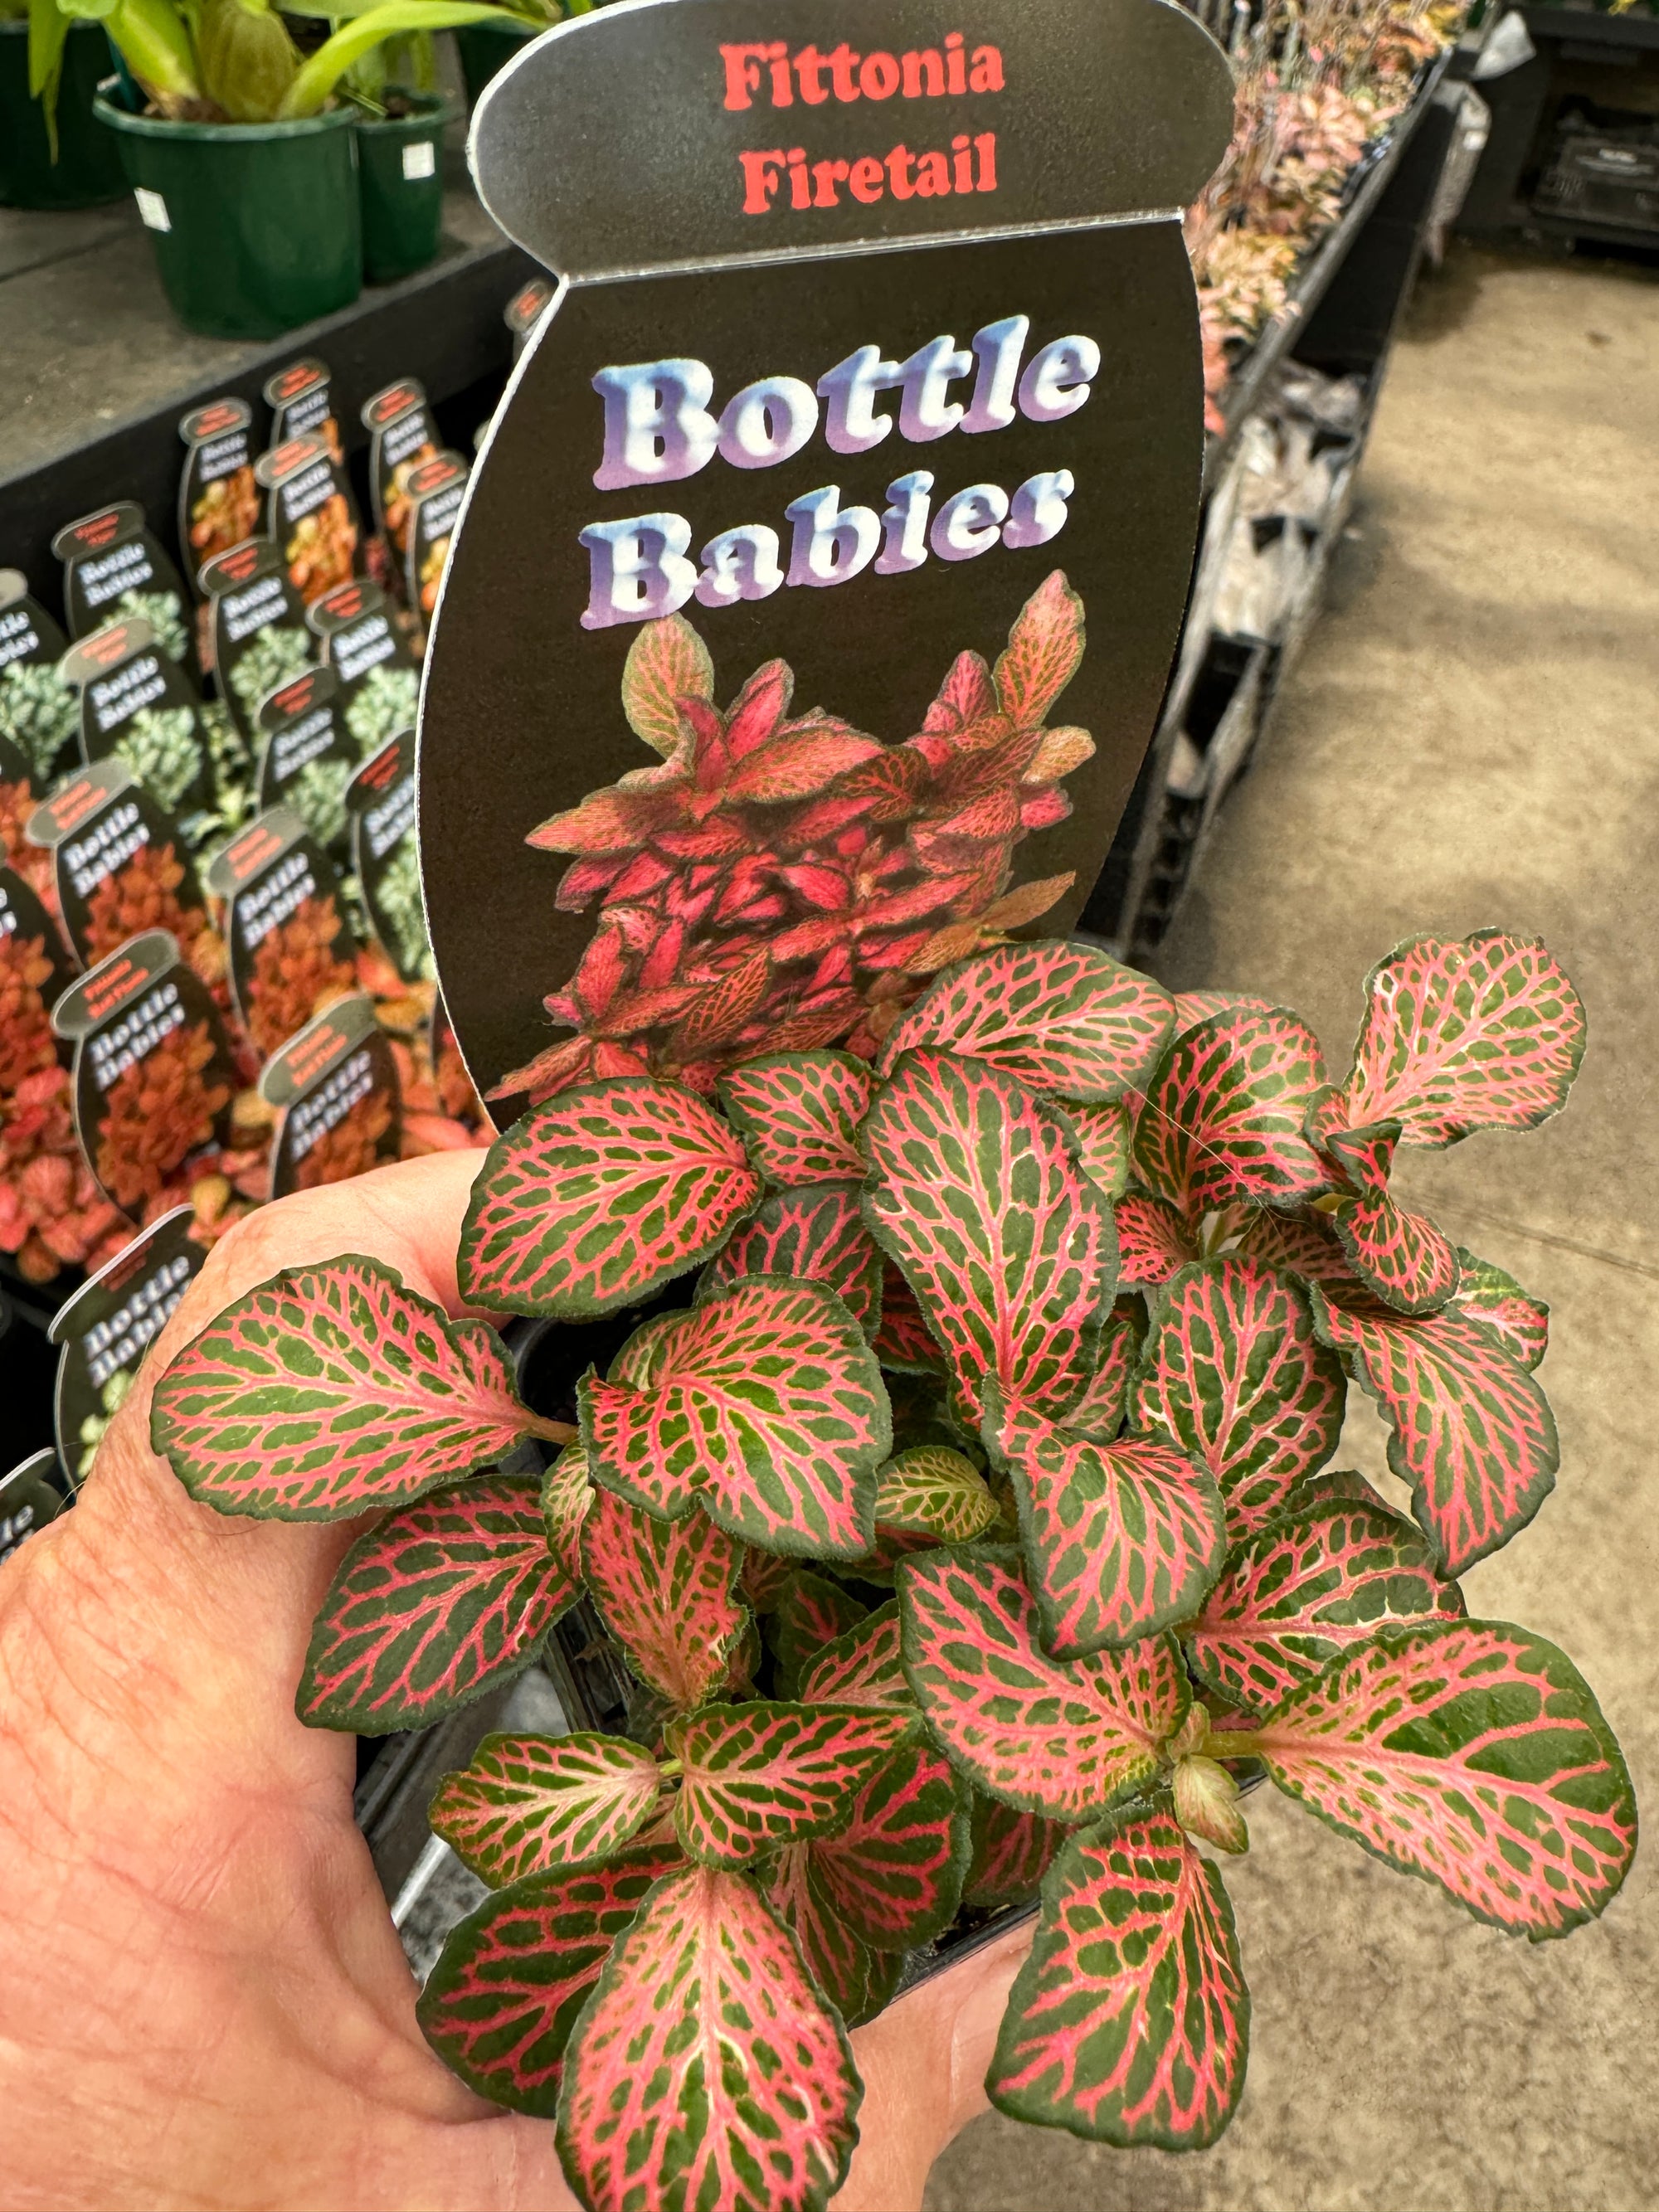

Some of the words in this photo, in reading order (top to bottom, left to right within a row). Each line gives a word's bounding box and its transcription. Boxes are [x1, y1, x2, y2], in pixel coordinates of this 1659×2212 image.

[719, 32, 1005, 110] Fittonia
[739, 133, 996, 214] Firetail
[592, 314, 1101, 490] Bottle
[579, 469, 1074, 630] Babies
